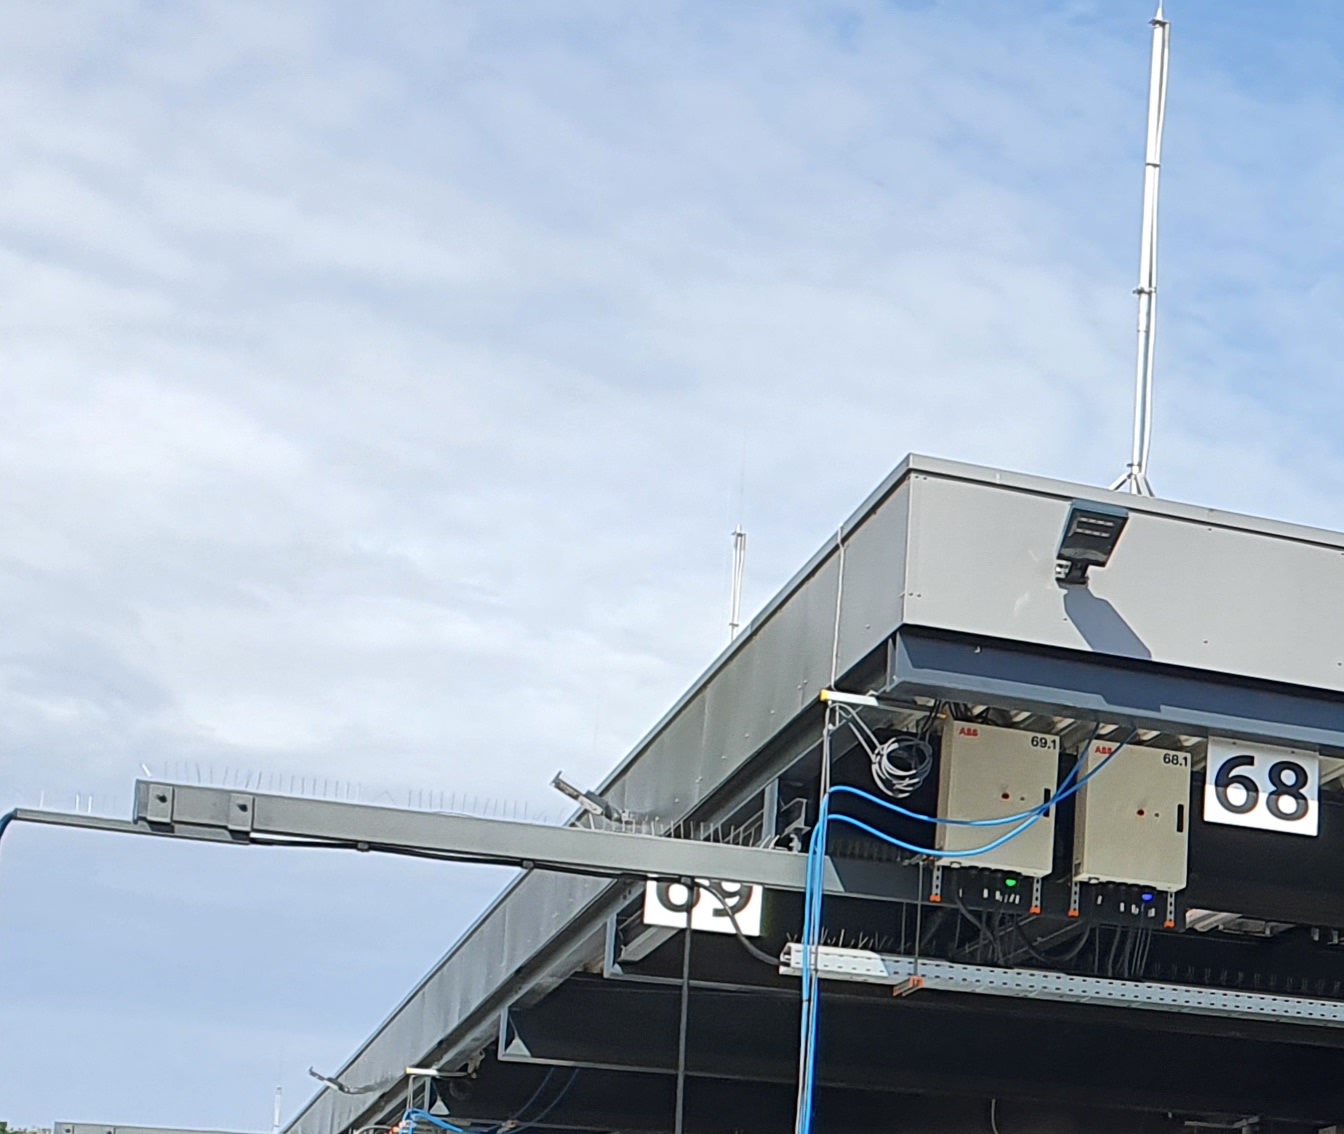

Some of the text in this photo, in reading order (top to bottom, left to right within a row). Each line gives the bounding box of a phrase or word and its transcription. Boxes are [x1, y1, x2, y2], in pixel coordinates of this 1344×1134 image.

[1030, 736, 1057, 751] 69.1
[1163, 752, 1189, 767] 68.1
[1214, 754, 1310, 822] 68
